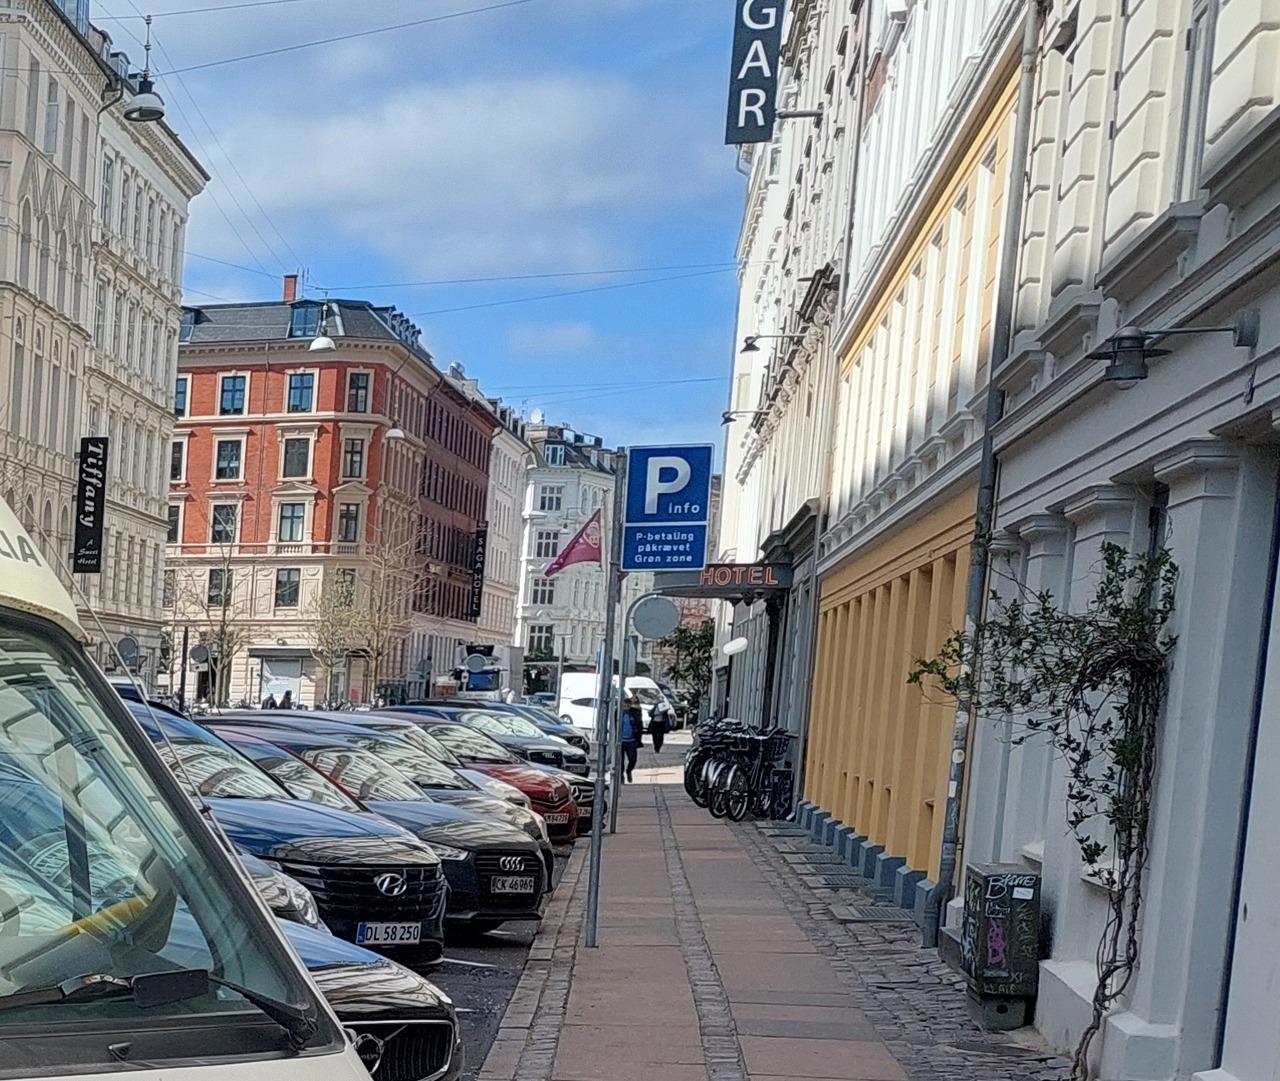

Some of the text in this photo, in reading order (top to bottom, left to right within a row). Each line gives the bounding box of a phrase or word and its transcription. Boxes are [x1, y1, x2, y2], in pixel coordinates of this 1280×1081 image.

[736, 0, 777, 128] GAR
[79, 441, 104, 528] Tiffany
[644, 456, 691, 515] P
[668, 502, 700, 514] info
[635, 530, 695, 541] P-betaling
[637, 543, 691, 553] påkrævet
[634, 554, 693, 563] Grøn zone
[472, 537, 484, 611] SAGA HOTEL
[699, 566, 779, 586] HOTEL
[365, 925, 420, 941] DL 58 250
